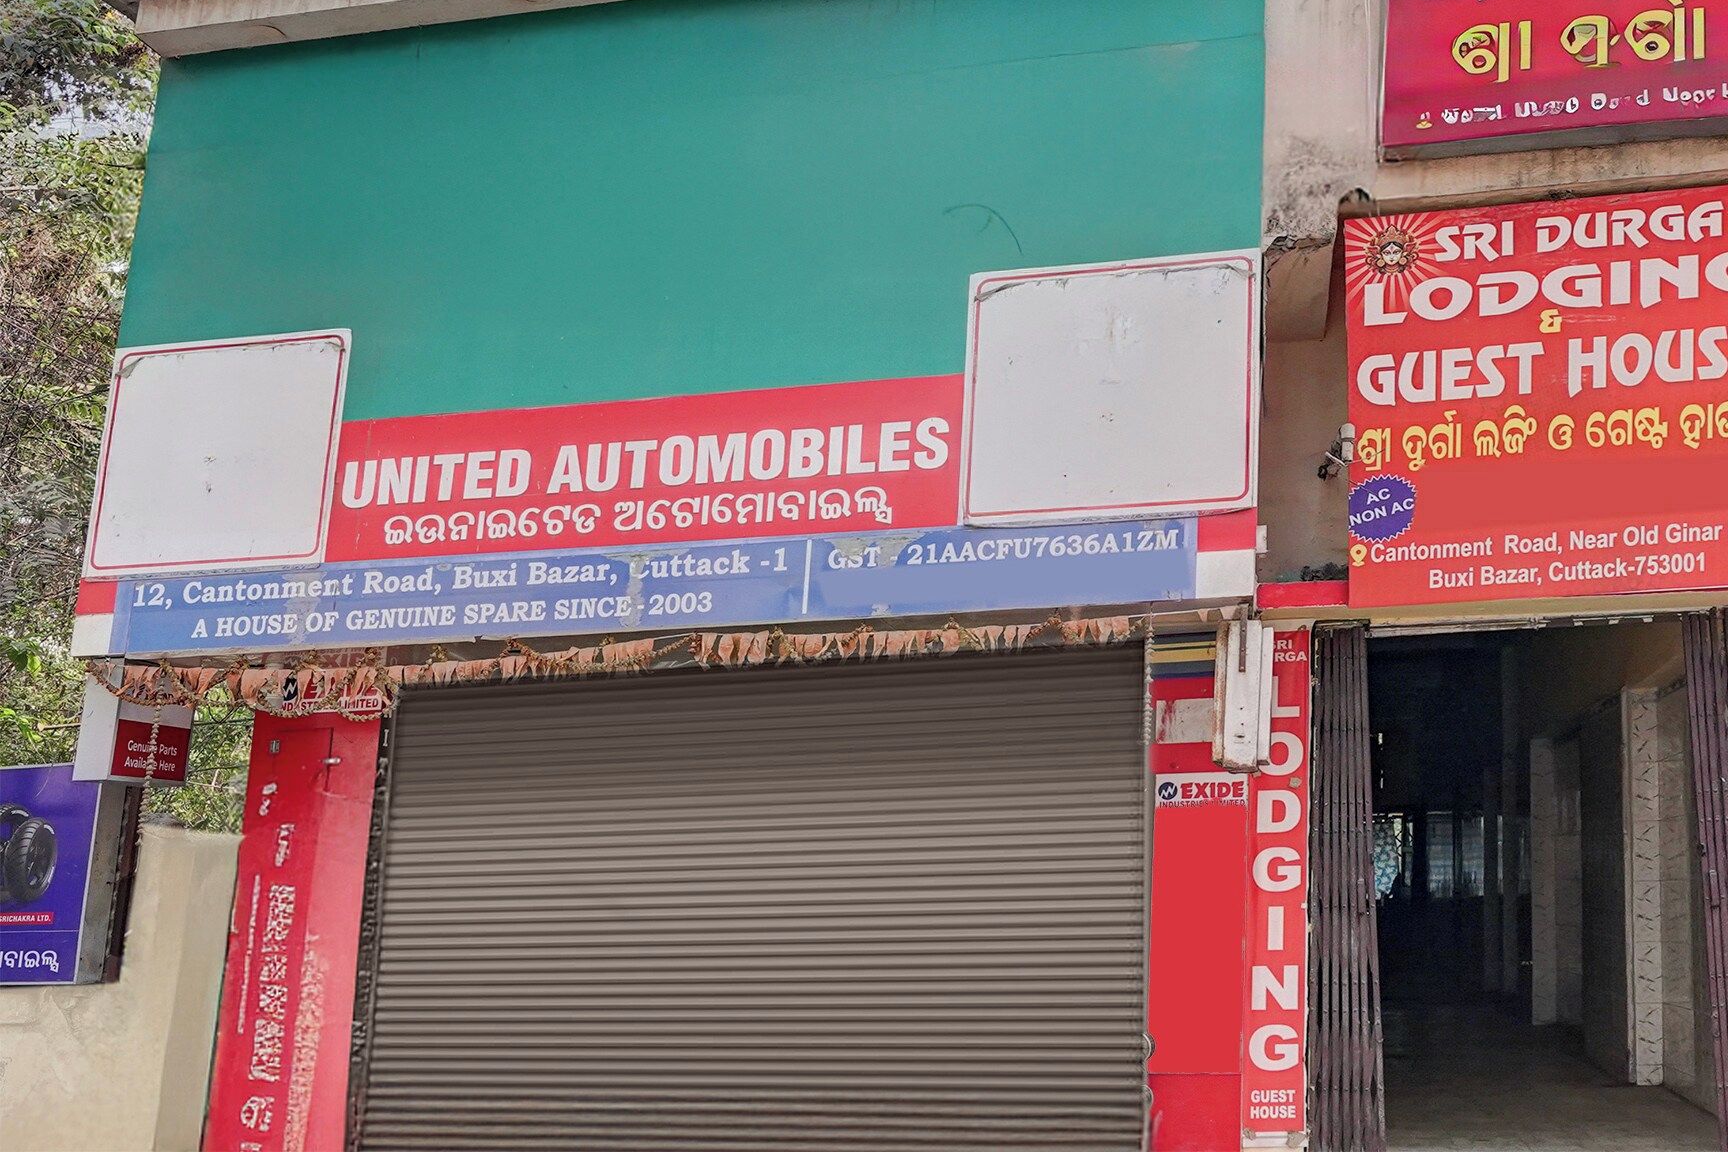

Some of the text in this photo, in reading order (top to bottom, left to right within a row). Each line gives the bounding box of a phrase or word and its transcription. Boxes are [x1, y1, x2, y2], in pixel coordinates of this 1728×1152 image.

[1433, 200, 1724, 264] SRI DURGA
[1539, 309, 1563, 334] &
[1356, 341, 1545, 407] GUEST
[1548, 414, 1576, 450] ଓ
[341, 417, 950, 509] UNITED AUTOMOBILES
[1349, 497, 1415, 527] NON AC
[1366, 489, 1391, 504] AC
[828, 546, 881, 570] GST
[907, 529, 1179, 566] 21AACFU7636A1ZM
[1370, 536, 1493, 564] Cantonment
[1504, 532, 1561, 557] Road,
[1569, 526, 1617, 550] Near
[1623, 524, 1662, 546] Old
[1665, 521, 1723, 544] Ginar
[133, 583, 173, 610] 12,
[183, 579, 354, 604] Cantonment
[363, 567, 441, 596] Road,
[452, 563, 517, 590] Buxi
[527, 561, 618, 587] Bazar,
[1429, 553, 1706, 589] Buxi Bazar, Cuttack-753001
[191, 618, 208, 639] A
[215, 614, 297, 637] HOUSE
[305, 612, 339, 633] OF
[345, 604, 455, 630] GENUINE
[463, 601, 546, 624] SPARE
[554, 597, 632, 620] SINCE
[649, 592, 712, 616] 2003
[1275, 651, 1308, 662] RGA
[124, 756, 176, 772] Availae Here
[128, 740, 177, 756] Genuie Parts
[1181, 781, 1244, 799] EXIDE
[1248, 675, 1304, 1071] LODGING
[37, 914, 51, 922] LTD.
[1250, 1089, 1295, 1103] GUEST
[1250, 1104, 1296, 1119] HOUSE
